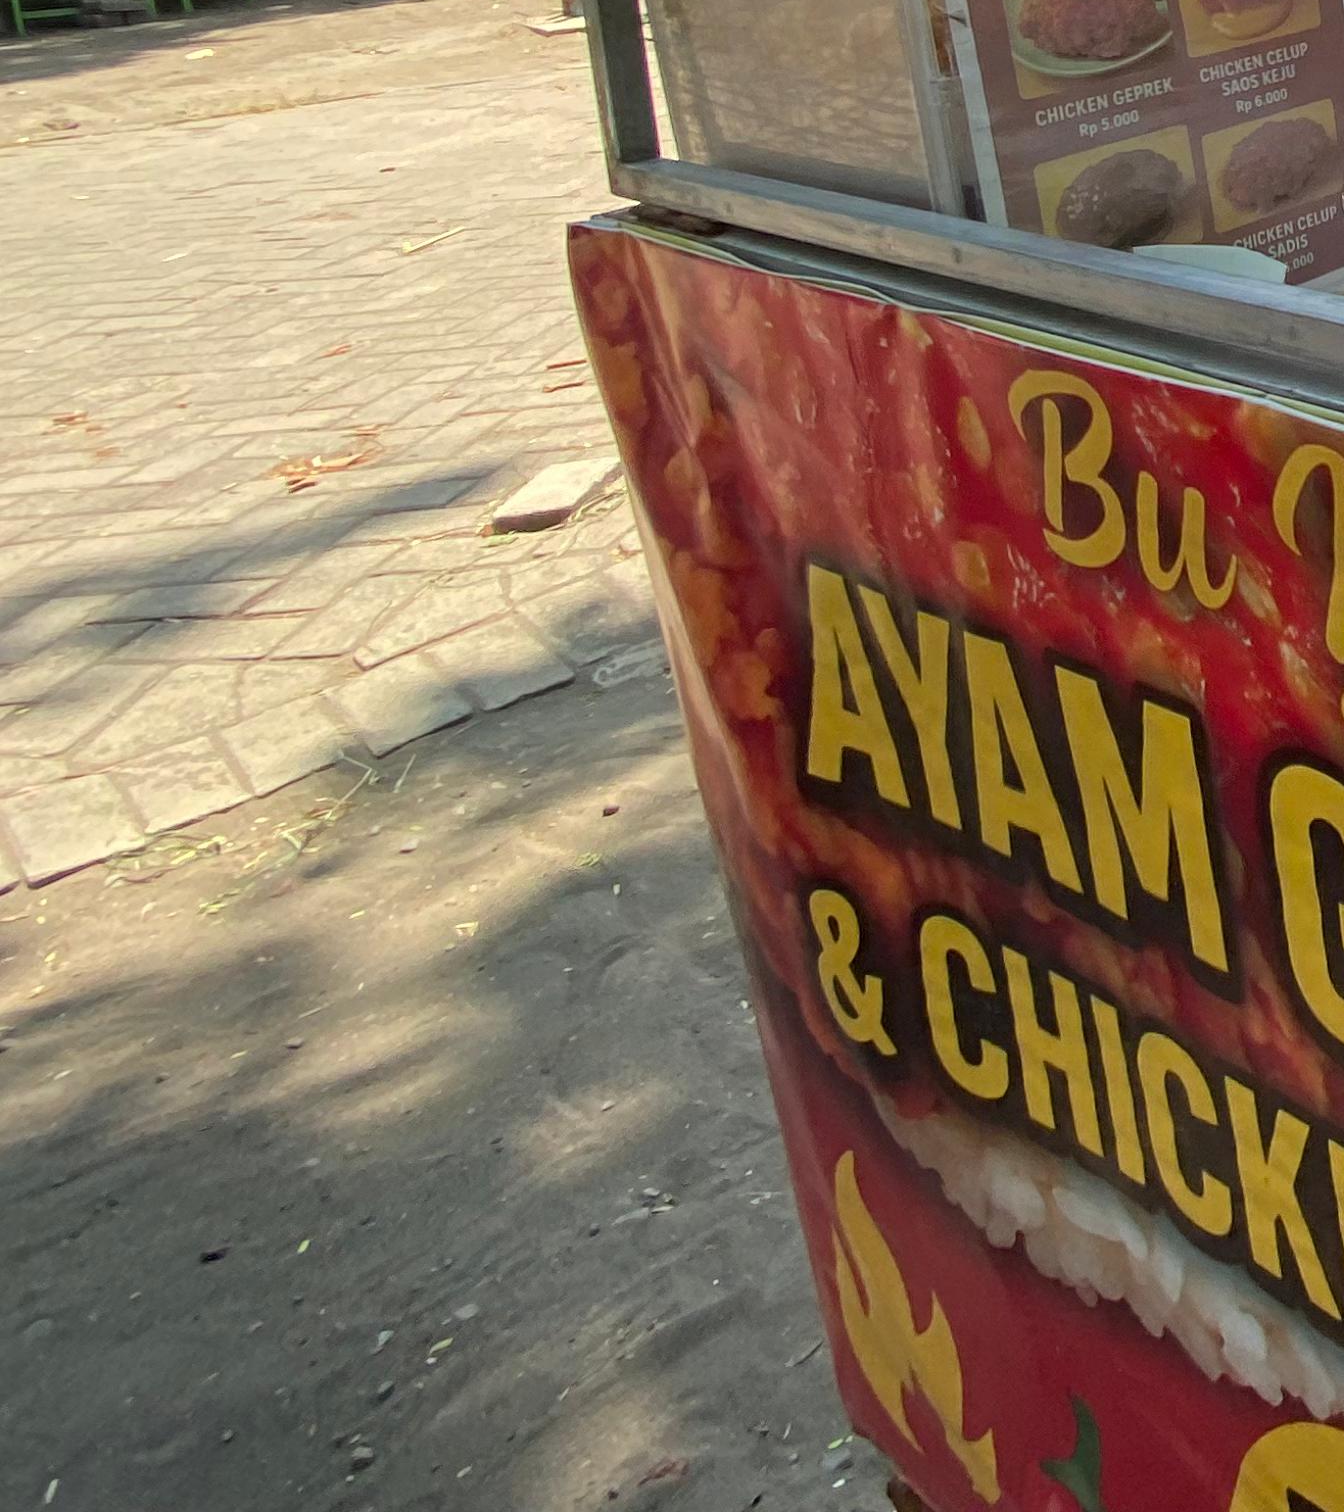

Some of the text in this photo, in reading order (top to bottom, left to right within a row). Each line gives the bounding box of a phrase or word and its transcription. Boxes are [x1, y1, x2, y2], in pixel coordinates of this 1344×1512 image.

[1200, 42, 1308, 83] CHICKEN CELUP
[1221, 64, 1296, 96] SAOS KEJU
[1035, 76, 1175, 127] CHICKEN GEPREK
[1236, 88, 1289, 115] Rp 6.000
[1079, 110, 1140, 138] Rp 5.000
[1234, 206, 1337, 249] CHICKEN CELUP
[1268, 233, 1309, 258] SADIS
[1007, 368, 1238, 610] Bu
[807, 564, 1228, 972] AYAM
[809, 888, 898, 1056] &
